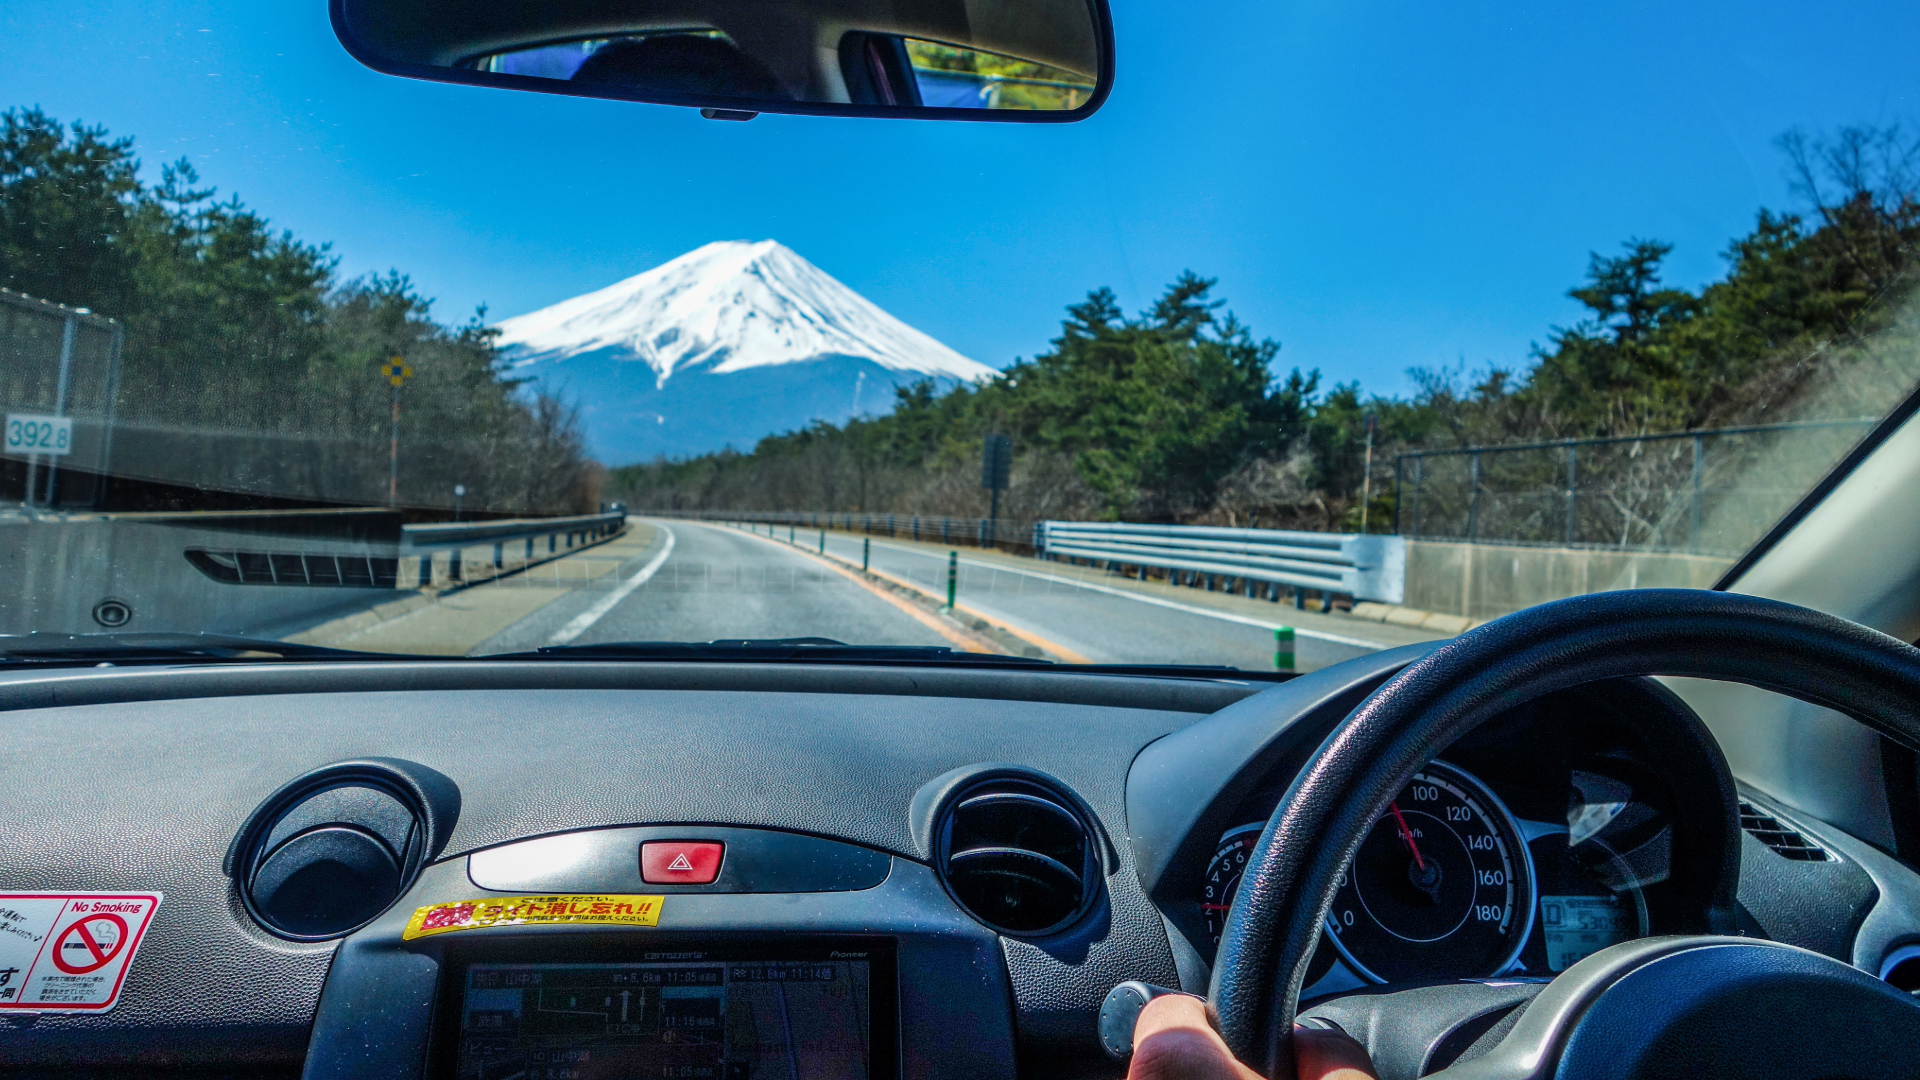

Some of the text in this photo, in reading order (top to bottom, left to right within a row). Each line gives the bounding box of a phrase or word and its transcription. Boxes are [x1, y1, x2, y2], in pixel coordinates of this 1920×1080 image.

[1412, 786, 1438, 801] 100
[1446, 806, 1471, 821] 120
[1468, 835, 1494, 850] 140
[1236, 852, 1244, 863] 6
[1222, 859, 1231, 871] 5
[1211, 871, 1220, 883] 4
[1478, 870, 1504, 886] 160
[1205, 886, 1214, 898] 3
[71, 902, 142, 913] No Smoking
[1475, 905, 1501, 921] 180
[1343, 910, 1355, 926] 0
[1208, 920, 1213, 932] 1
[645, 952, 703, 960] carrozzeria
[830, 951, 868, 959] Pioneer
